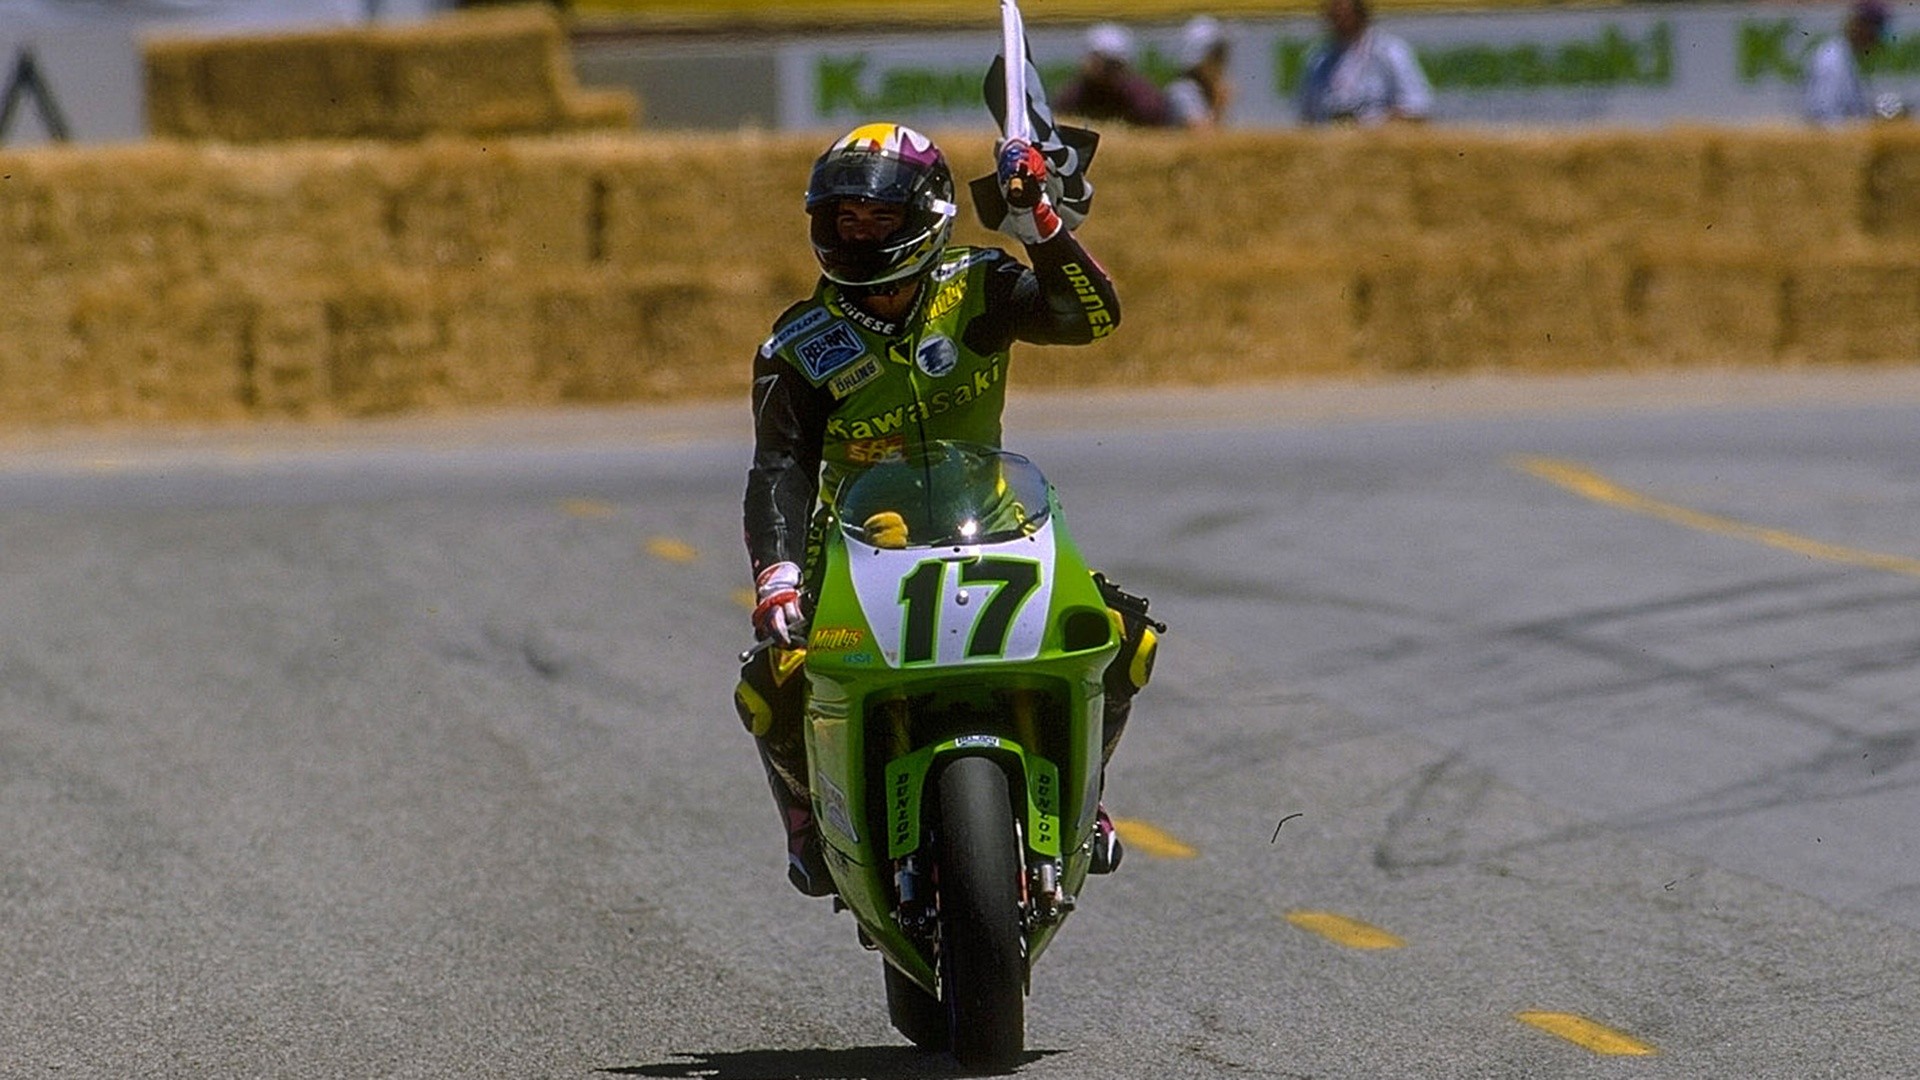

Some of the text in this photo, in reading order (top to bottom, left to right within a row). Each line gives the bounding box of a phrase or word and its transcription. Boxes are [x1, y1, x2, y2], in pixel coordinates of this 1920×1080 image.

[827, 356, 1000, 439] Kawasaki
[898, 555, 1043, 667] 17
[896, 772, 910, 846] DUNLOP
[1038, 774, 1052, 843] DUNLOP
